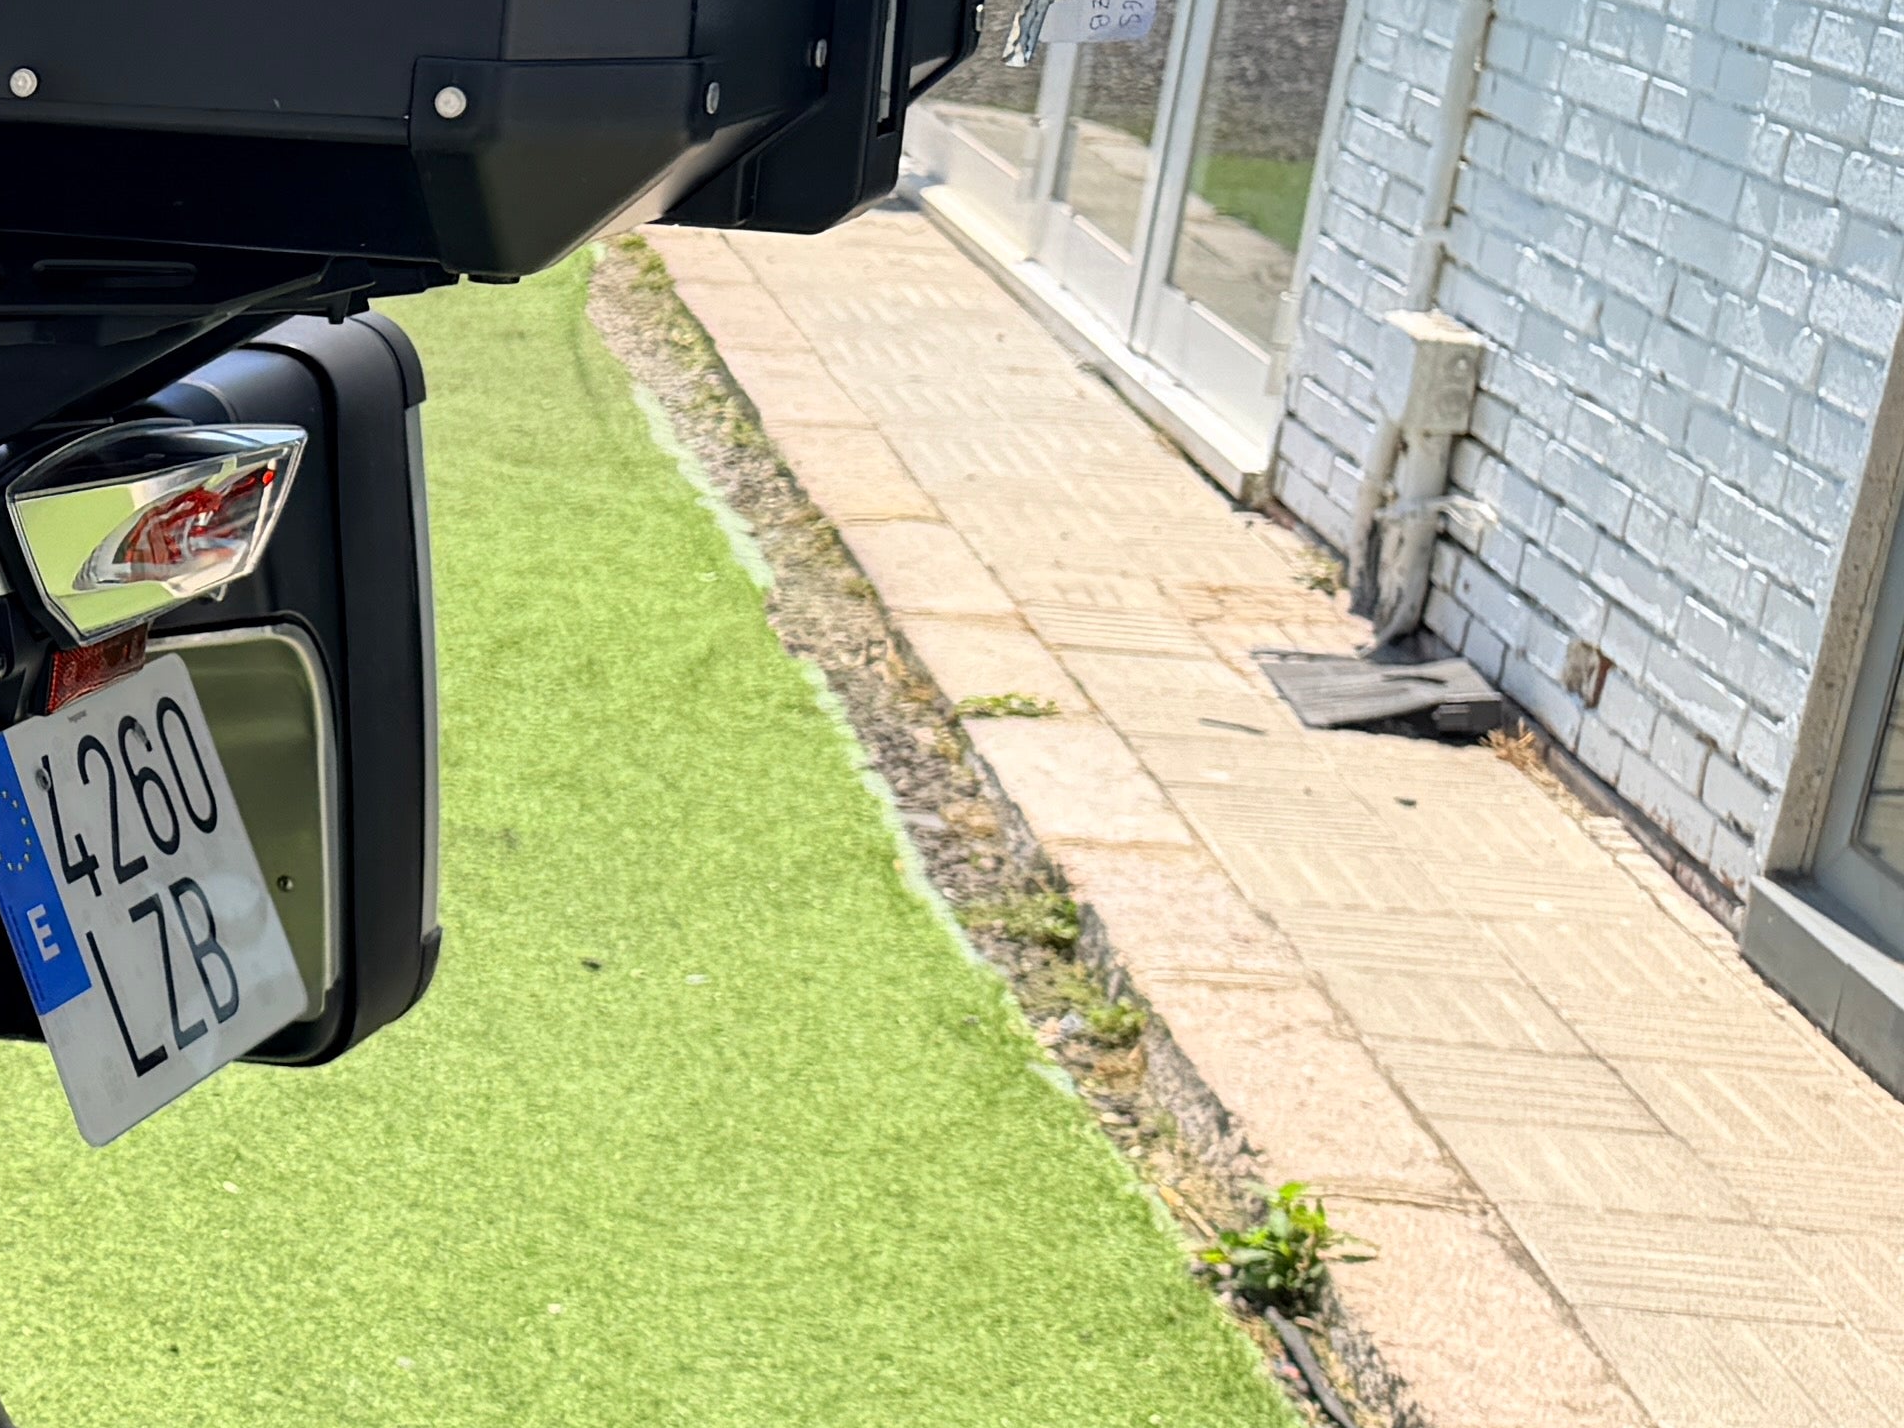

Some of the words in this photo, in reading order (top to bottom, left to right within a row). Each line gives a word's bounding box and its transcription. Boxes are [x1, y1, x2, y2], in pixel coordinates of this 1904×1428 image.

[41, 696, 218, 898] 4260
[25, 902, 62, 963] E
[84, 876, 240, 1079] LZB
